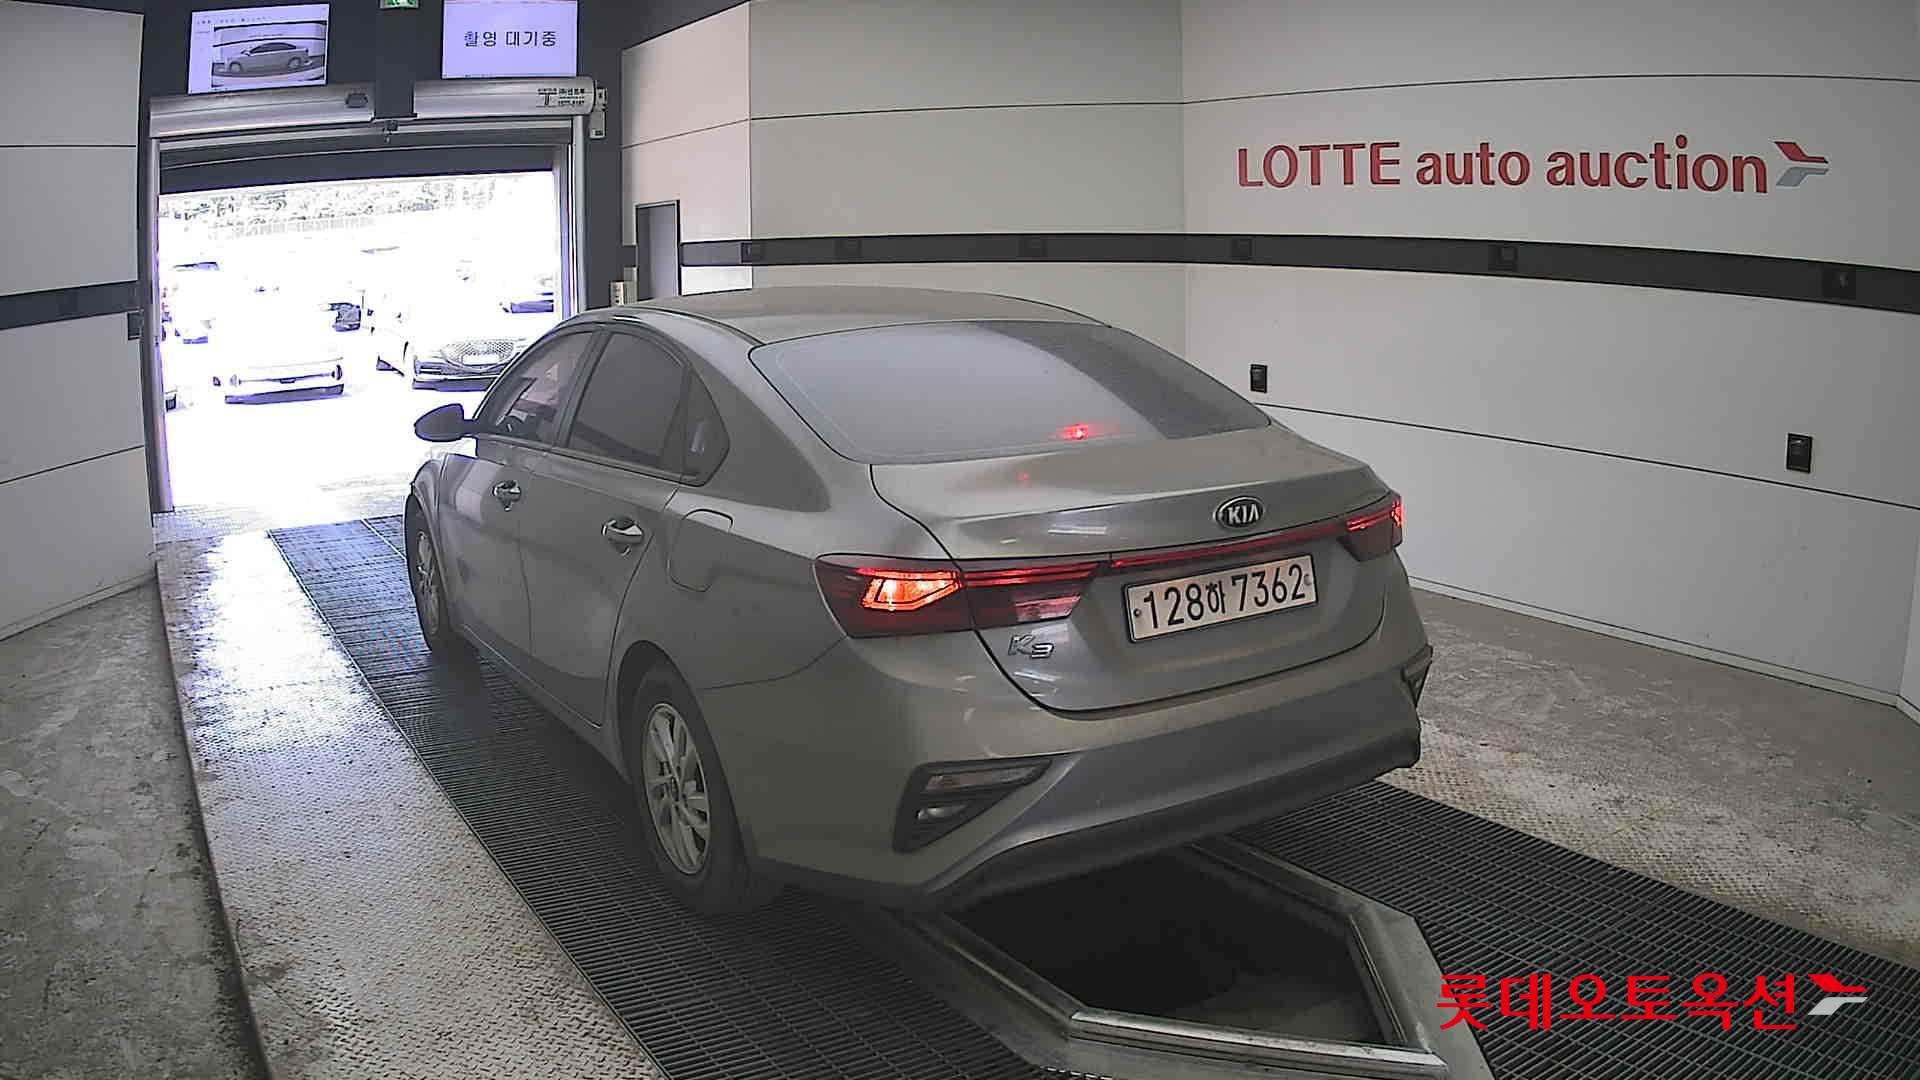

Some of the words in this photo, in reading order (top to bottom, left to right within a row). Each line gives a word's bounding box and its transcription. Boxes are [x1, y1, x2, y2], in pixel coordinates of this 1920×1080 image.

[464, 31, 497, 47] 촬영
[505, 31, 556, 47] 대기중
[1239, 143, 1399, 187] LOTTE
[1417, 143, 1530, 186] auto
[1546, 135, 1767, 193] auction
[1227, 503, 1259, 524] KIA
[1143, 580, 1227, 629] 128하
[1231, 563, 1307, 612] 7362
[1008, 634, 1055, 659] K3
